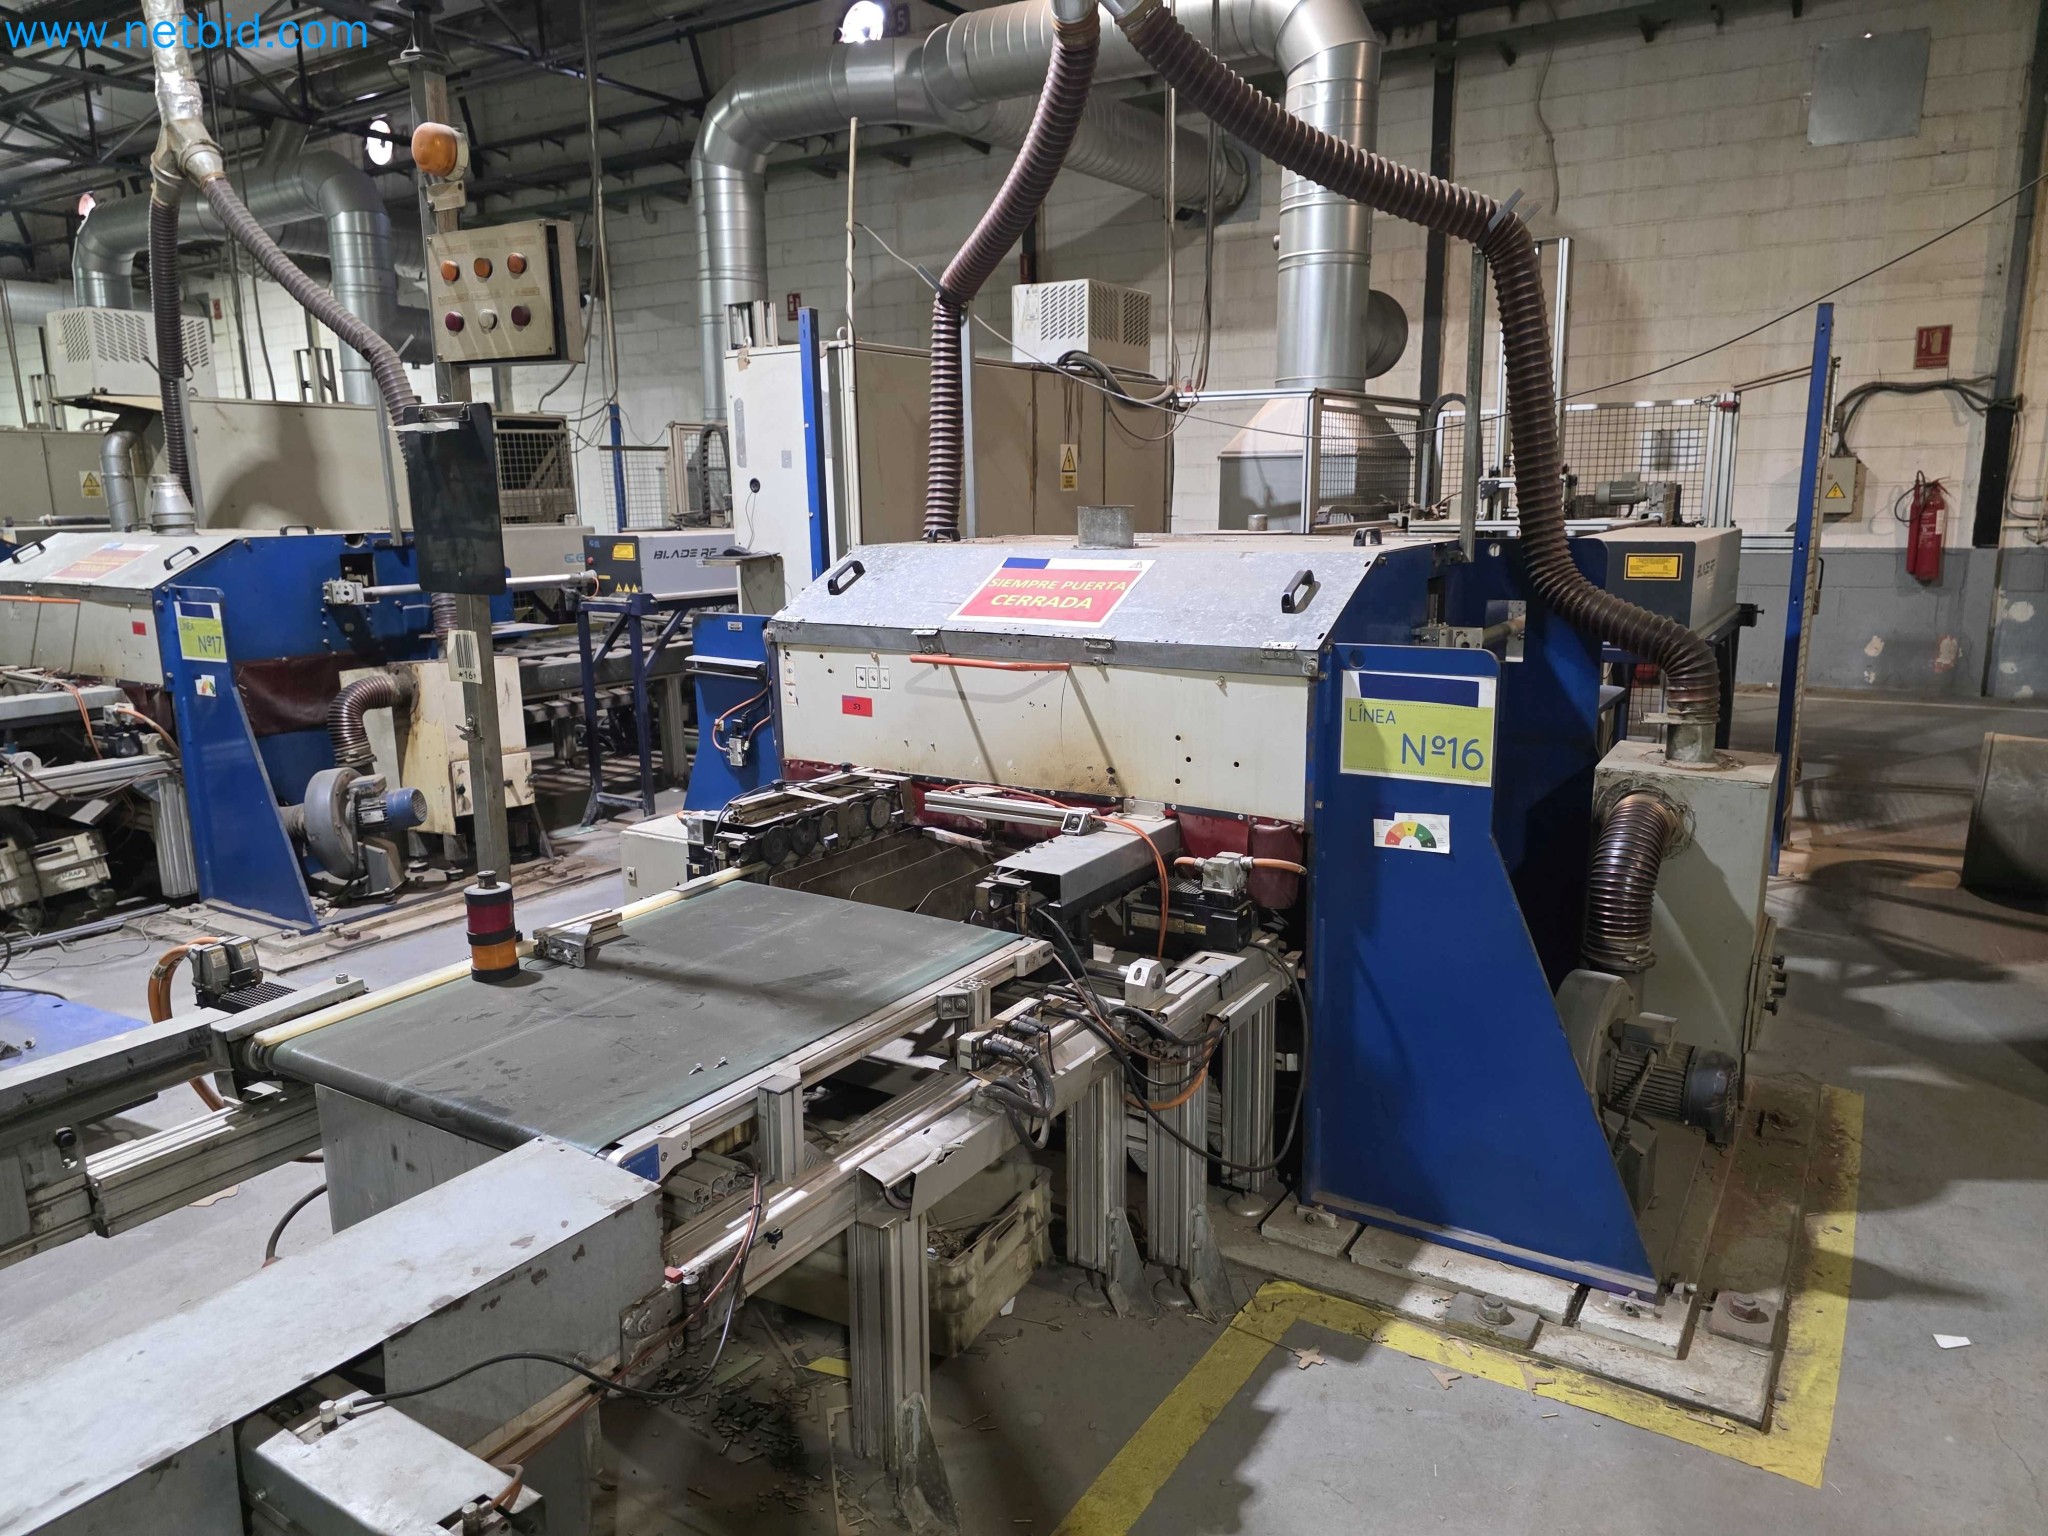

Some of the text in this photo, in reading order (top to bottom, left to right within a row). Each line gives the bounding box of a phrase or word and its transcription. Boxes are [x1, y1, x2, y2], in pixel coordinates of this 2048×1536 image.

[653, 547, 717, 560] BLADE RF
[987, 578, 1126, 590] SIEMPRE PUERTA
[990, 594, 1092, 609] CERRADA
[197, 635, 222, 654] Nº17
[1348, 703, 1396, 725] LÍNEA
[1401, 732, 1484, 771] Nº16
